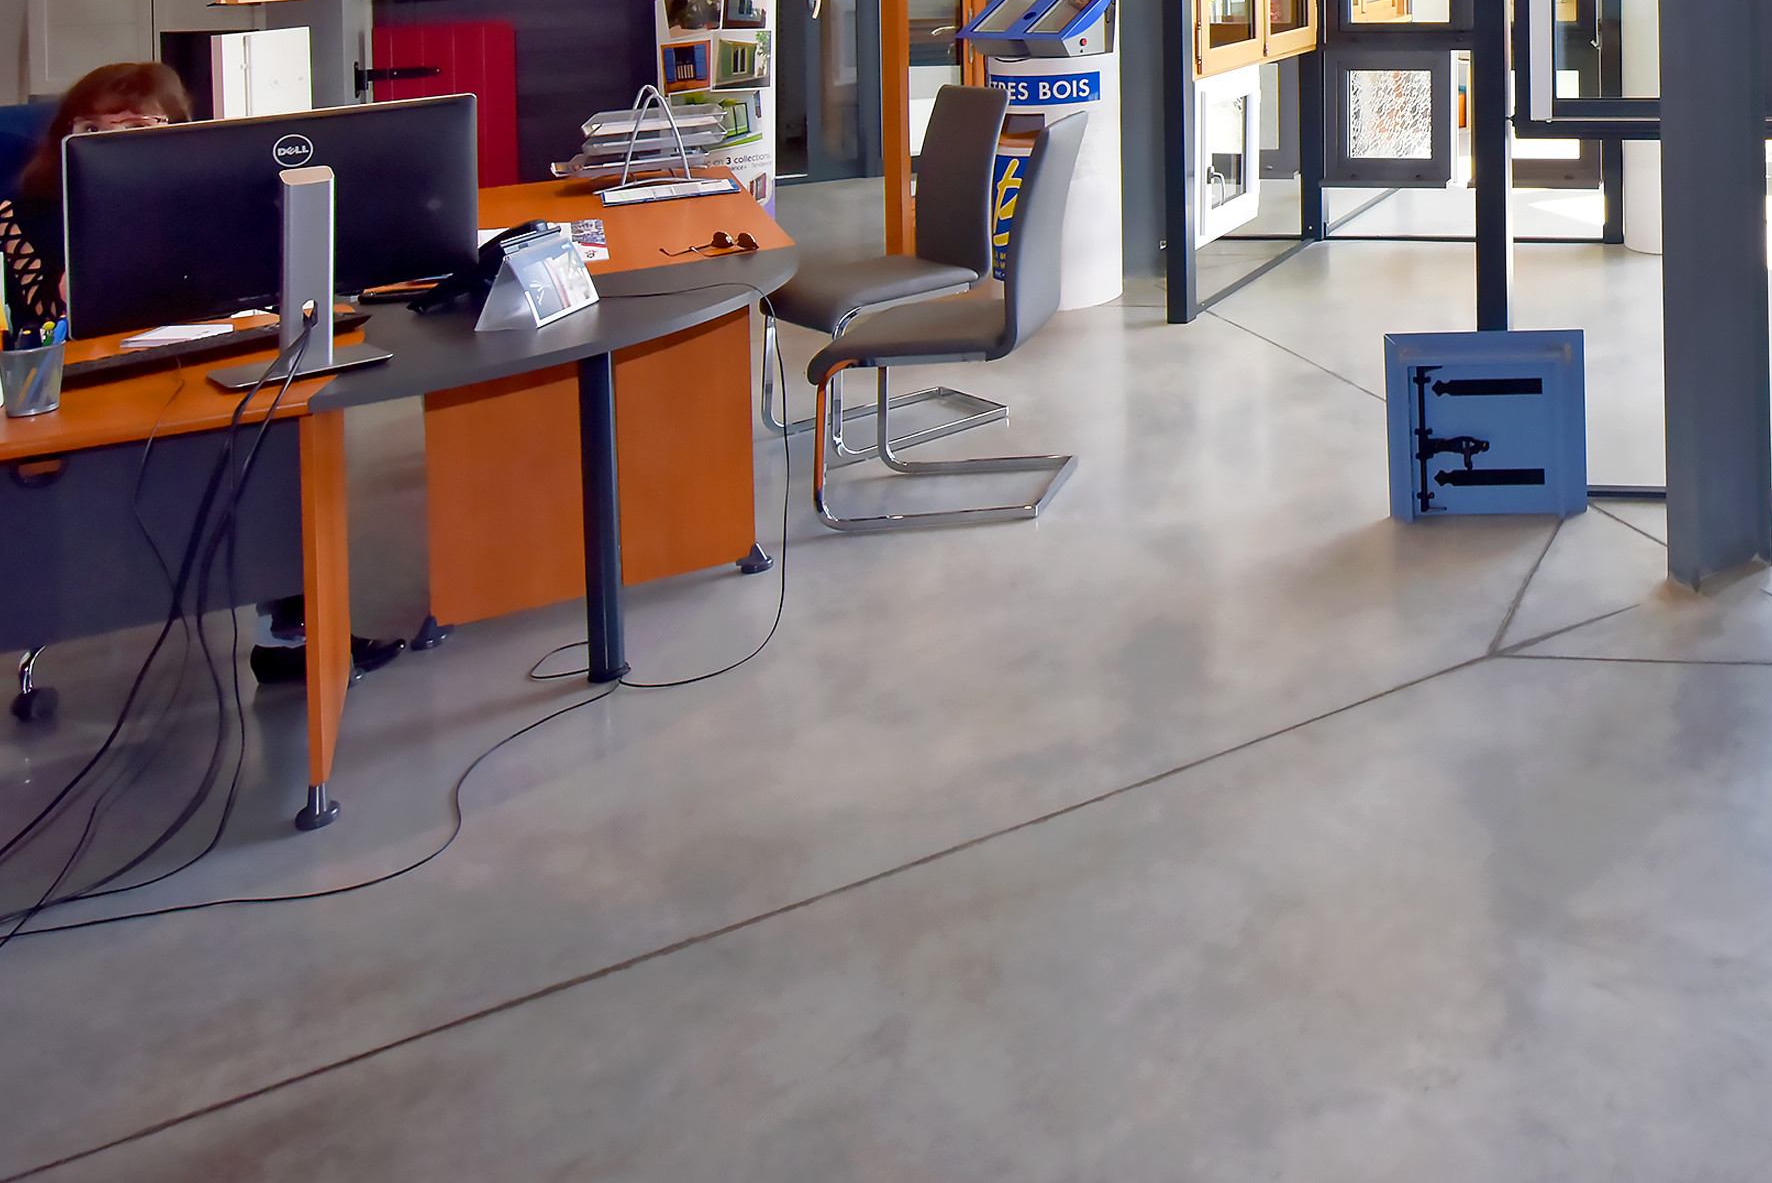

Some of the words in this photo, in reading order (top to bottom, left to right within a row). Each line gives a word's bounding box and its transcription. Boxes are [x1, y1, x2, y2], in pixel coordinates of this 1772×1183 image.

[1038, 78, 1091, 100] BOIS
[277, 145, 309, 157] DELL
[726, 156, 732, 165] 3
[733, 153, 771, 164] collections
